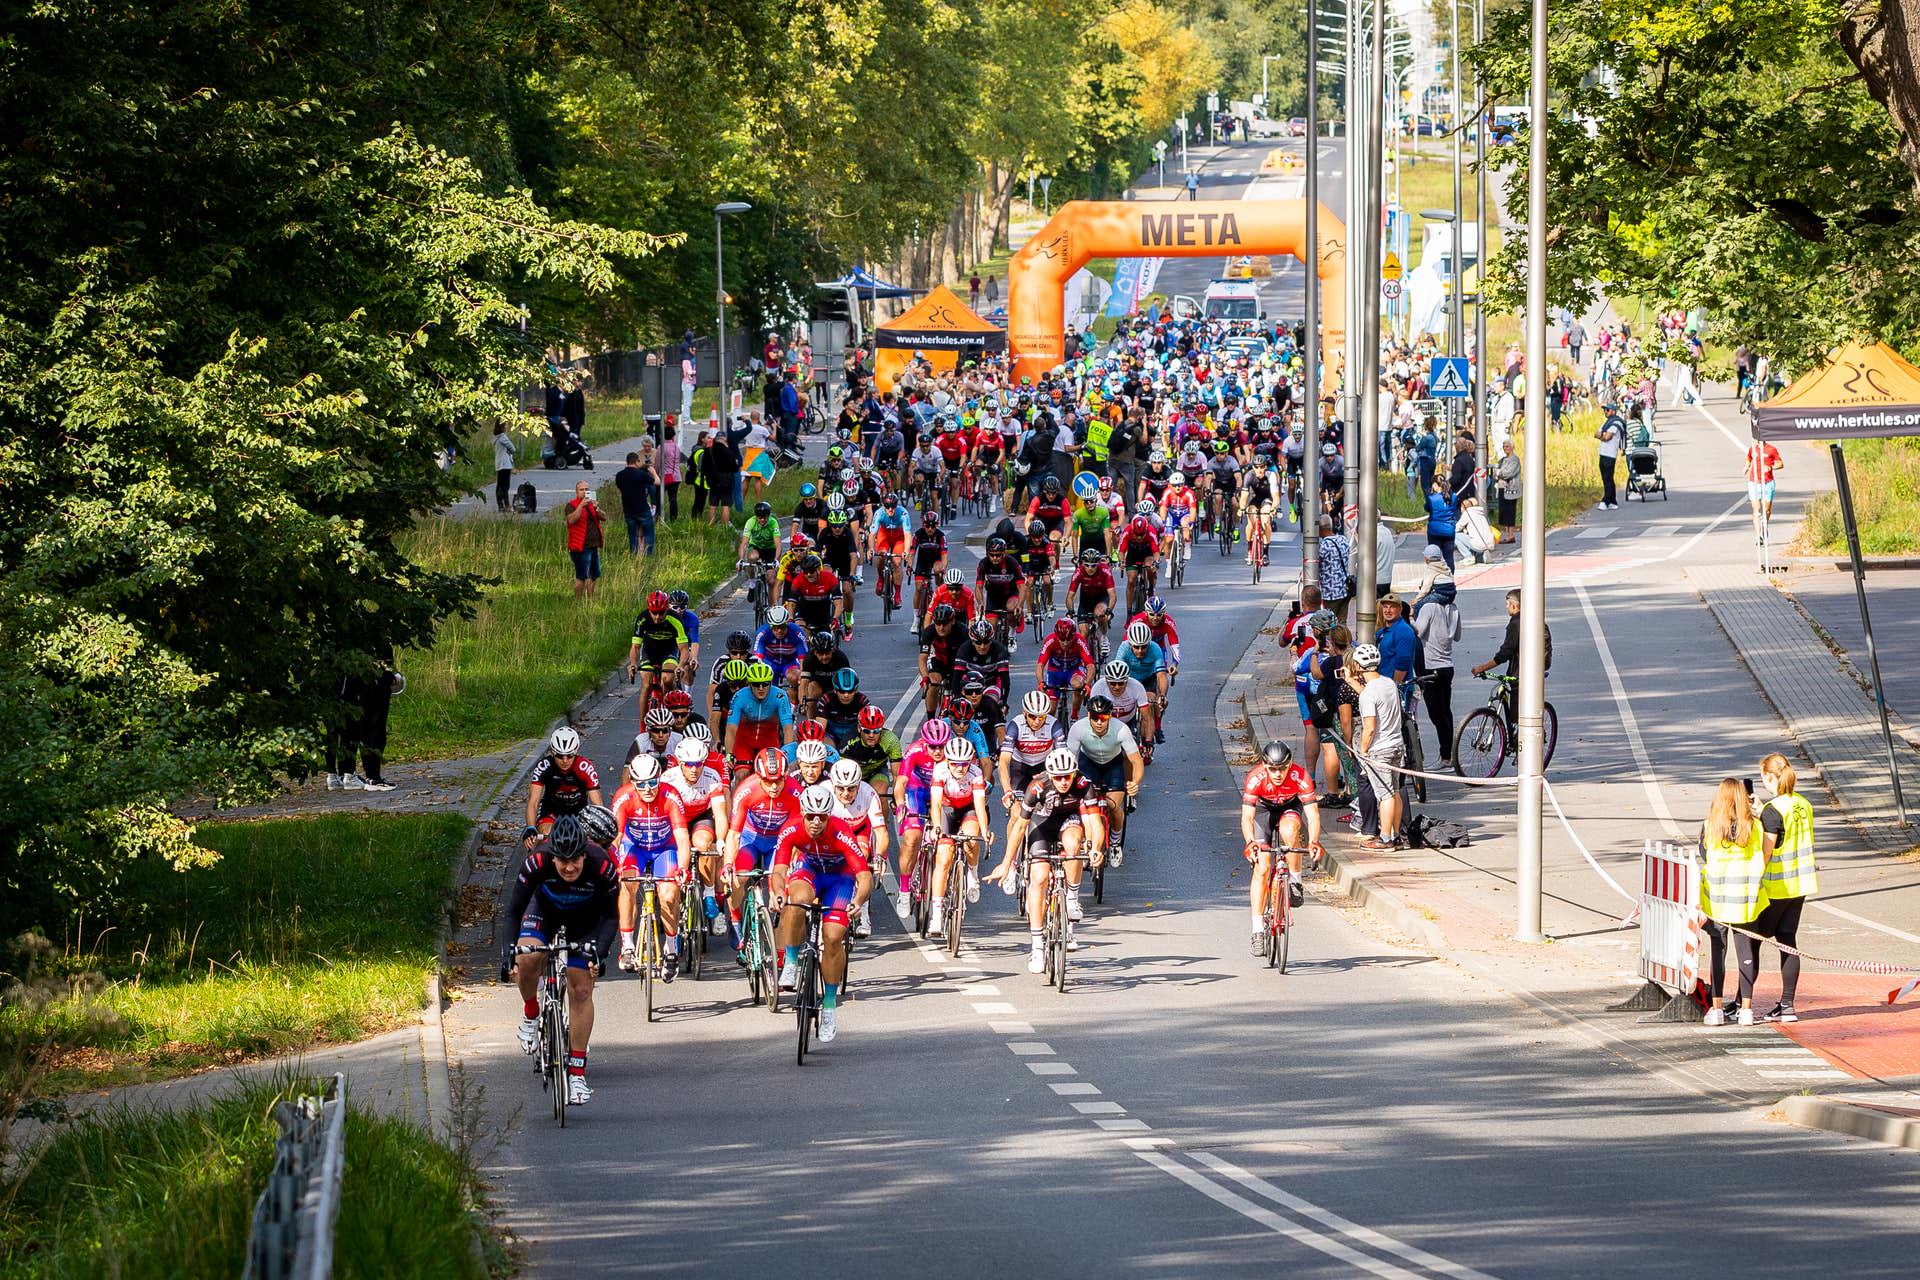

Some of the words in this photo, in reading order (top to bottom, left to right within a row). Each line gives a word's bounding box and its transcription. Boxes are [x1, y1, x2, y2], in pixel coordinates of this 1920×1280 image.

[1141, 213, 1241, 246] META
[1386, 284, 1400, 295] 20
[1090, 425, 1108, 436] FOTO
[579, 761, 600, 787] ORCA
[836, 830, 864, 858] bekom
